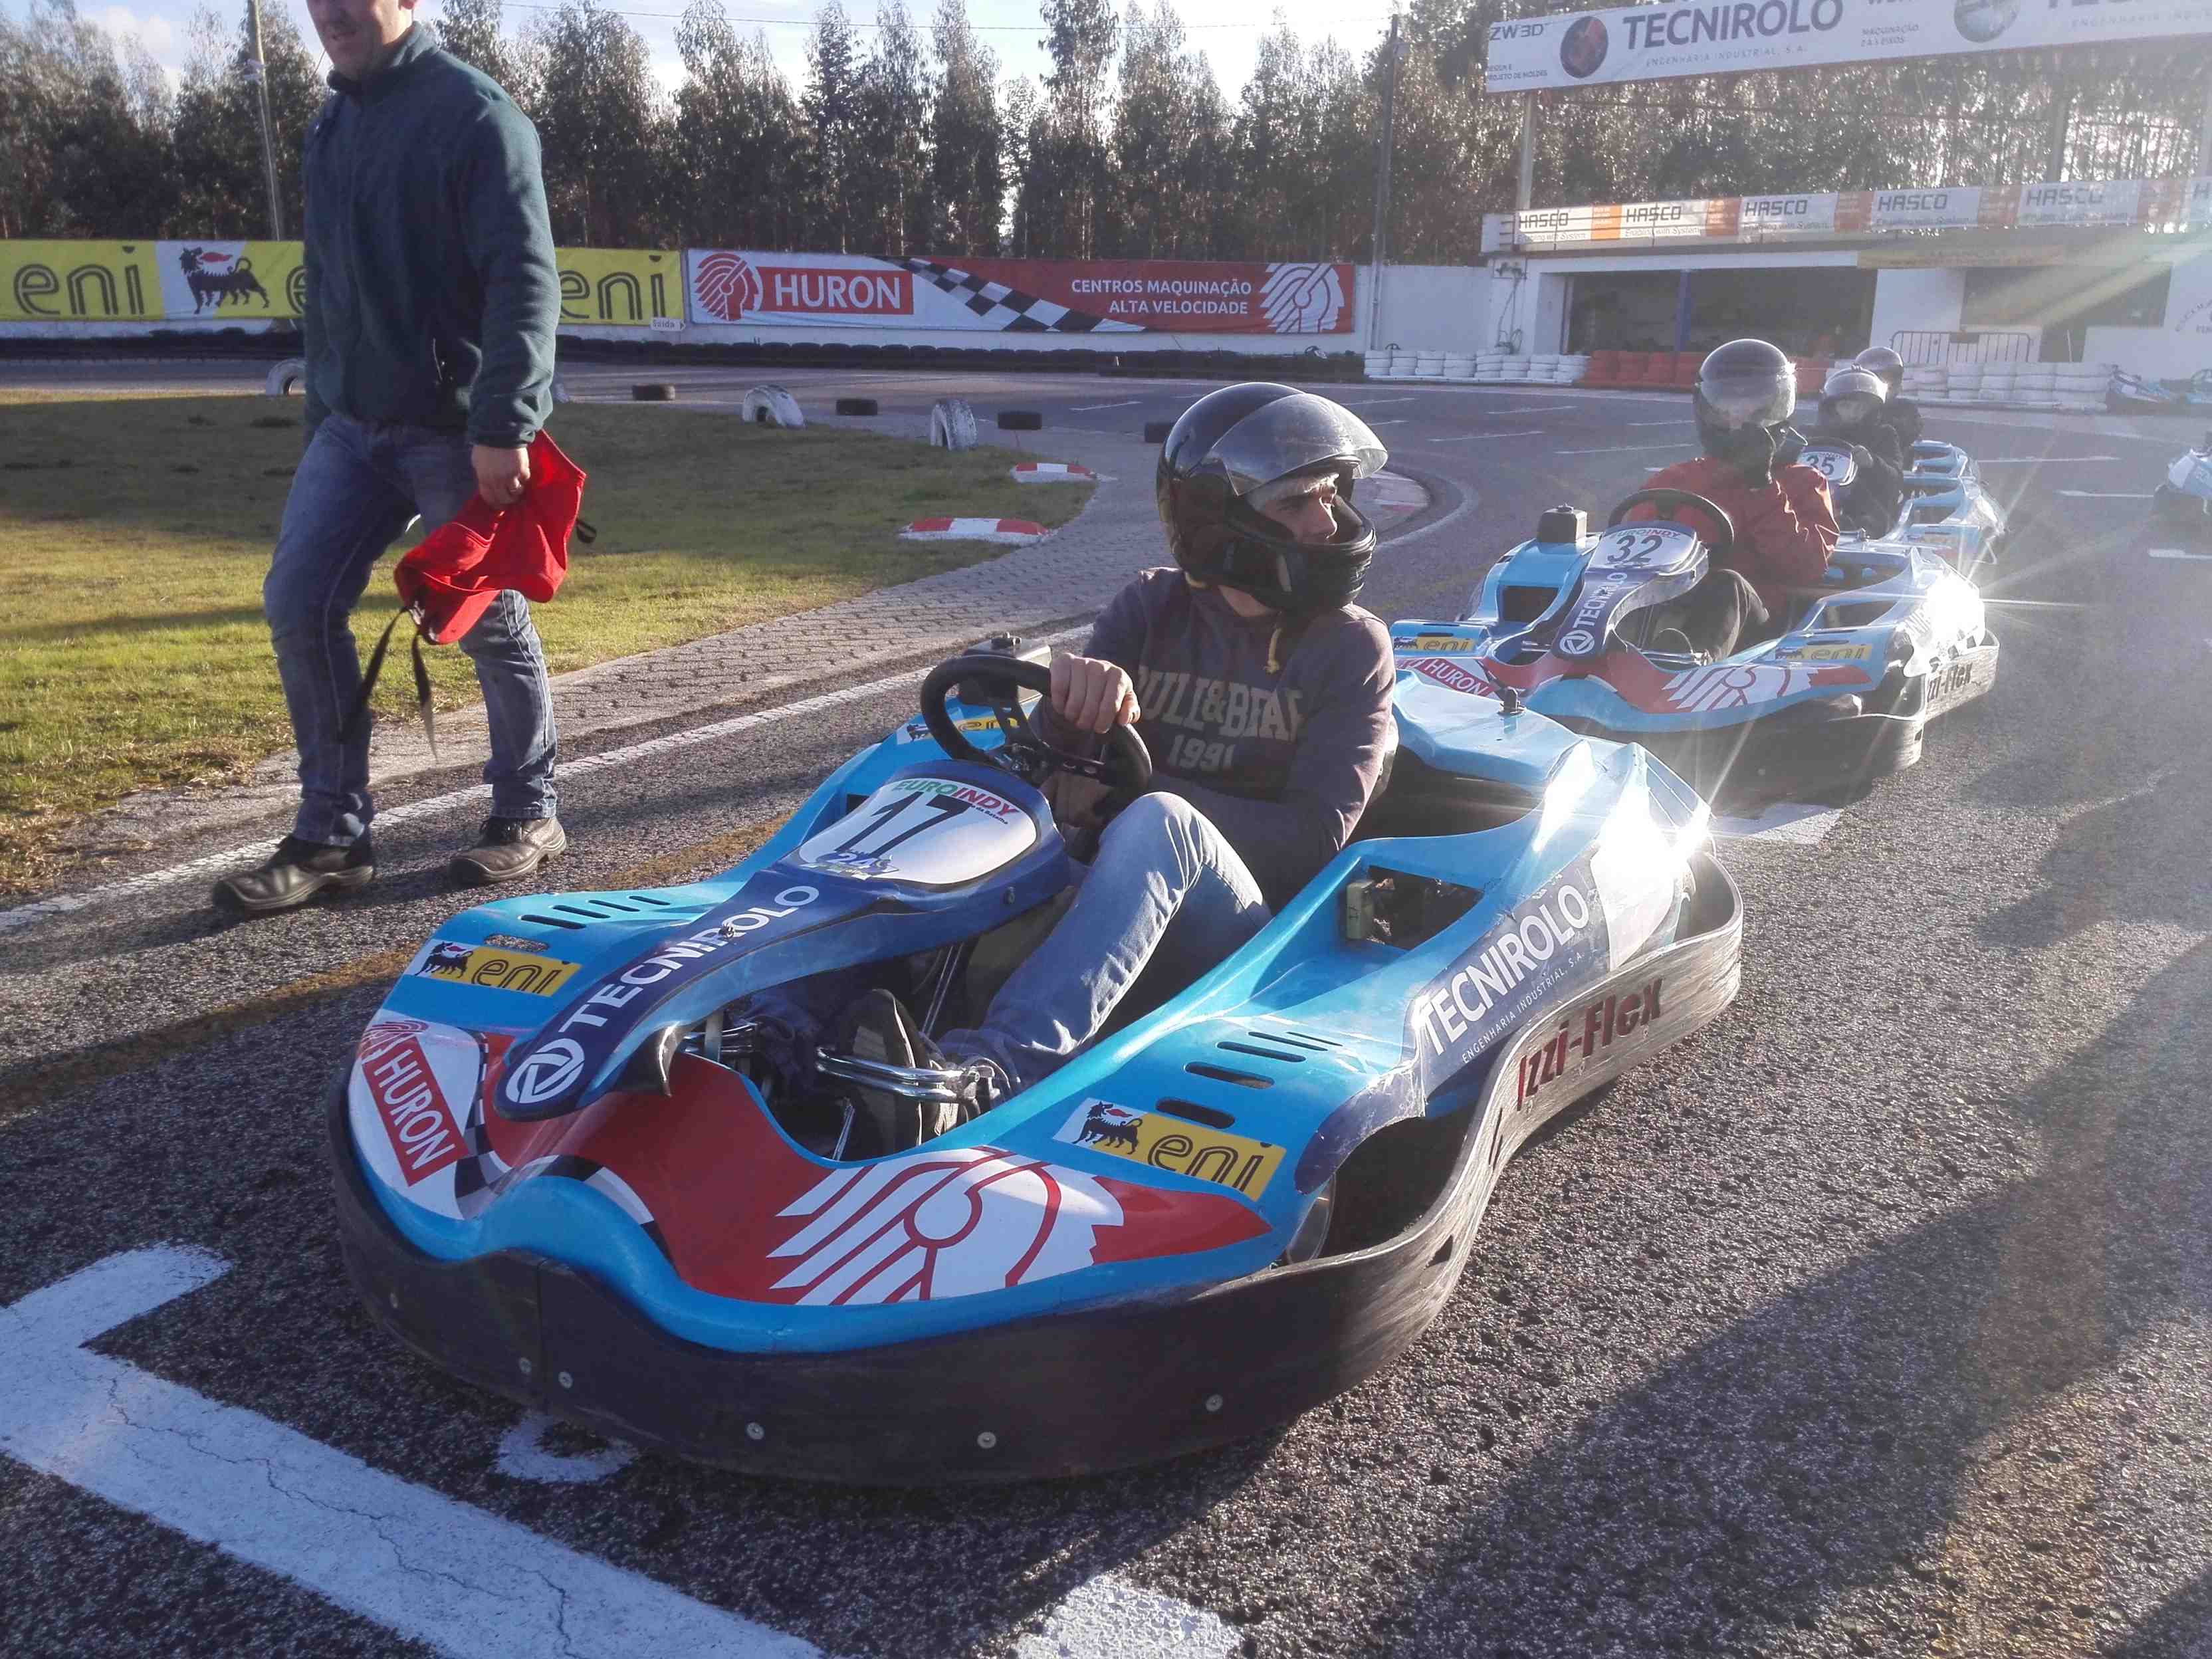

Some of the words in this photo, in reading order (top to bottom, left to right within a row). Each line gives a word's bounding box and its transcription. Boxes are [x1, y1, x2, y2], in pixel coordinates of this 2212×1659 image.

[1622, 0, 1844, 50] TECNIROLO
[1646, 54, 1710, 66] ENGENHARIA
[1519, 212, 1569, 229] HASCO
[1626, 207, 1681, 222] HASCO
[1745, 200, 1808, 216] HASCO
[1878, 194, 1947, 211] HASCO
[13, 246, 145, 315] eni
[558, 255, 665, 320] eni
[775, 273, 901, 309] HURON
[1071, 279, 1143, 294] CENTROS
[1147, 278, 1252, 296] MAQUINAÇÃO
[1109, 300, 1149, 315] ALTA
[1153, 300, 1248, 315] VELOCIDADE
[1607, 535, 1663, 563] 32
[1424, 637, 1470, 651] eni
[1424, 659, 1489, 695] HURON
[1167, 734, 1236, 772] 1991
[895, 780, 1020, 817] EUROINDY
[834, 791, 971, 857] 17
[471, 959, 572, 995] eni
[558, 886, 820, 1033] TECNIROLO
[1416, 885, 1589, 1055] TECNIROLO
[1462, 1011, 1516, 1063] ENGENHARIA
[1516, 967, 1568, 1014] INDUSTRIAL,
[374, 1049, 456, 1170] HURON
[1148, 1134, 1272, 1192] eni
